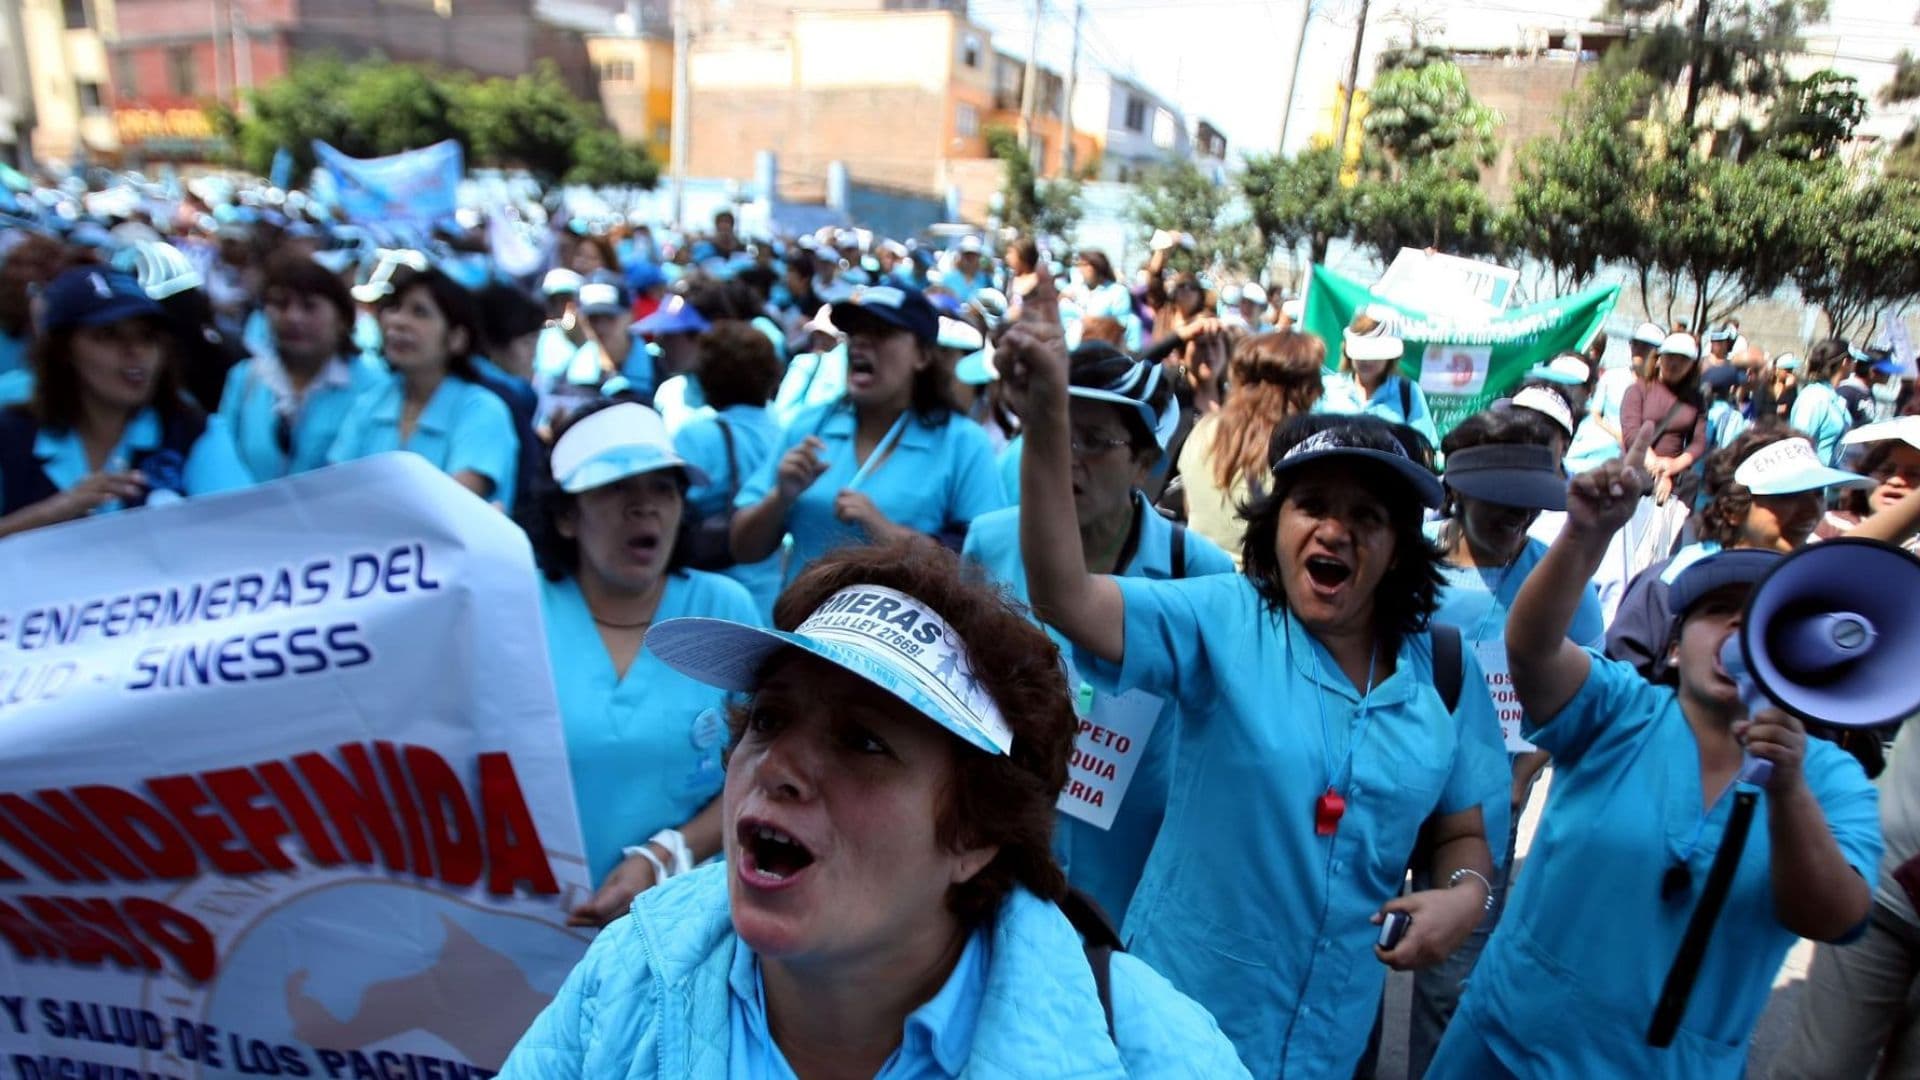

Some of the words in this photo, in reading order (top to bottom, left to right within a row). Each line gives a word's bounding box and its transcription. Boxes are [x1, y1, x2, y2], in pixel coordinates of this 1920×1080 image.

[18, 560, 332, 650] ENFERMERAS
[346, 542, 440, 599] DEL
[126, 622, 372, 690] SINESSS
[850, 617, 880, 633] LEY
[878, 627, 925, 658] 27669!
[1078, 718, 1131, 754] PETO
[0, 740, 559, 895] INDEFINIDA
[0, 996, 27, 1034] Y
[38, 997, 165, 1051] SALUD
[172, 1017, 223, 1069] DE
[228, 1032, 311, 1078] LOS
